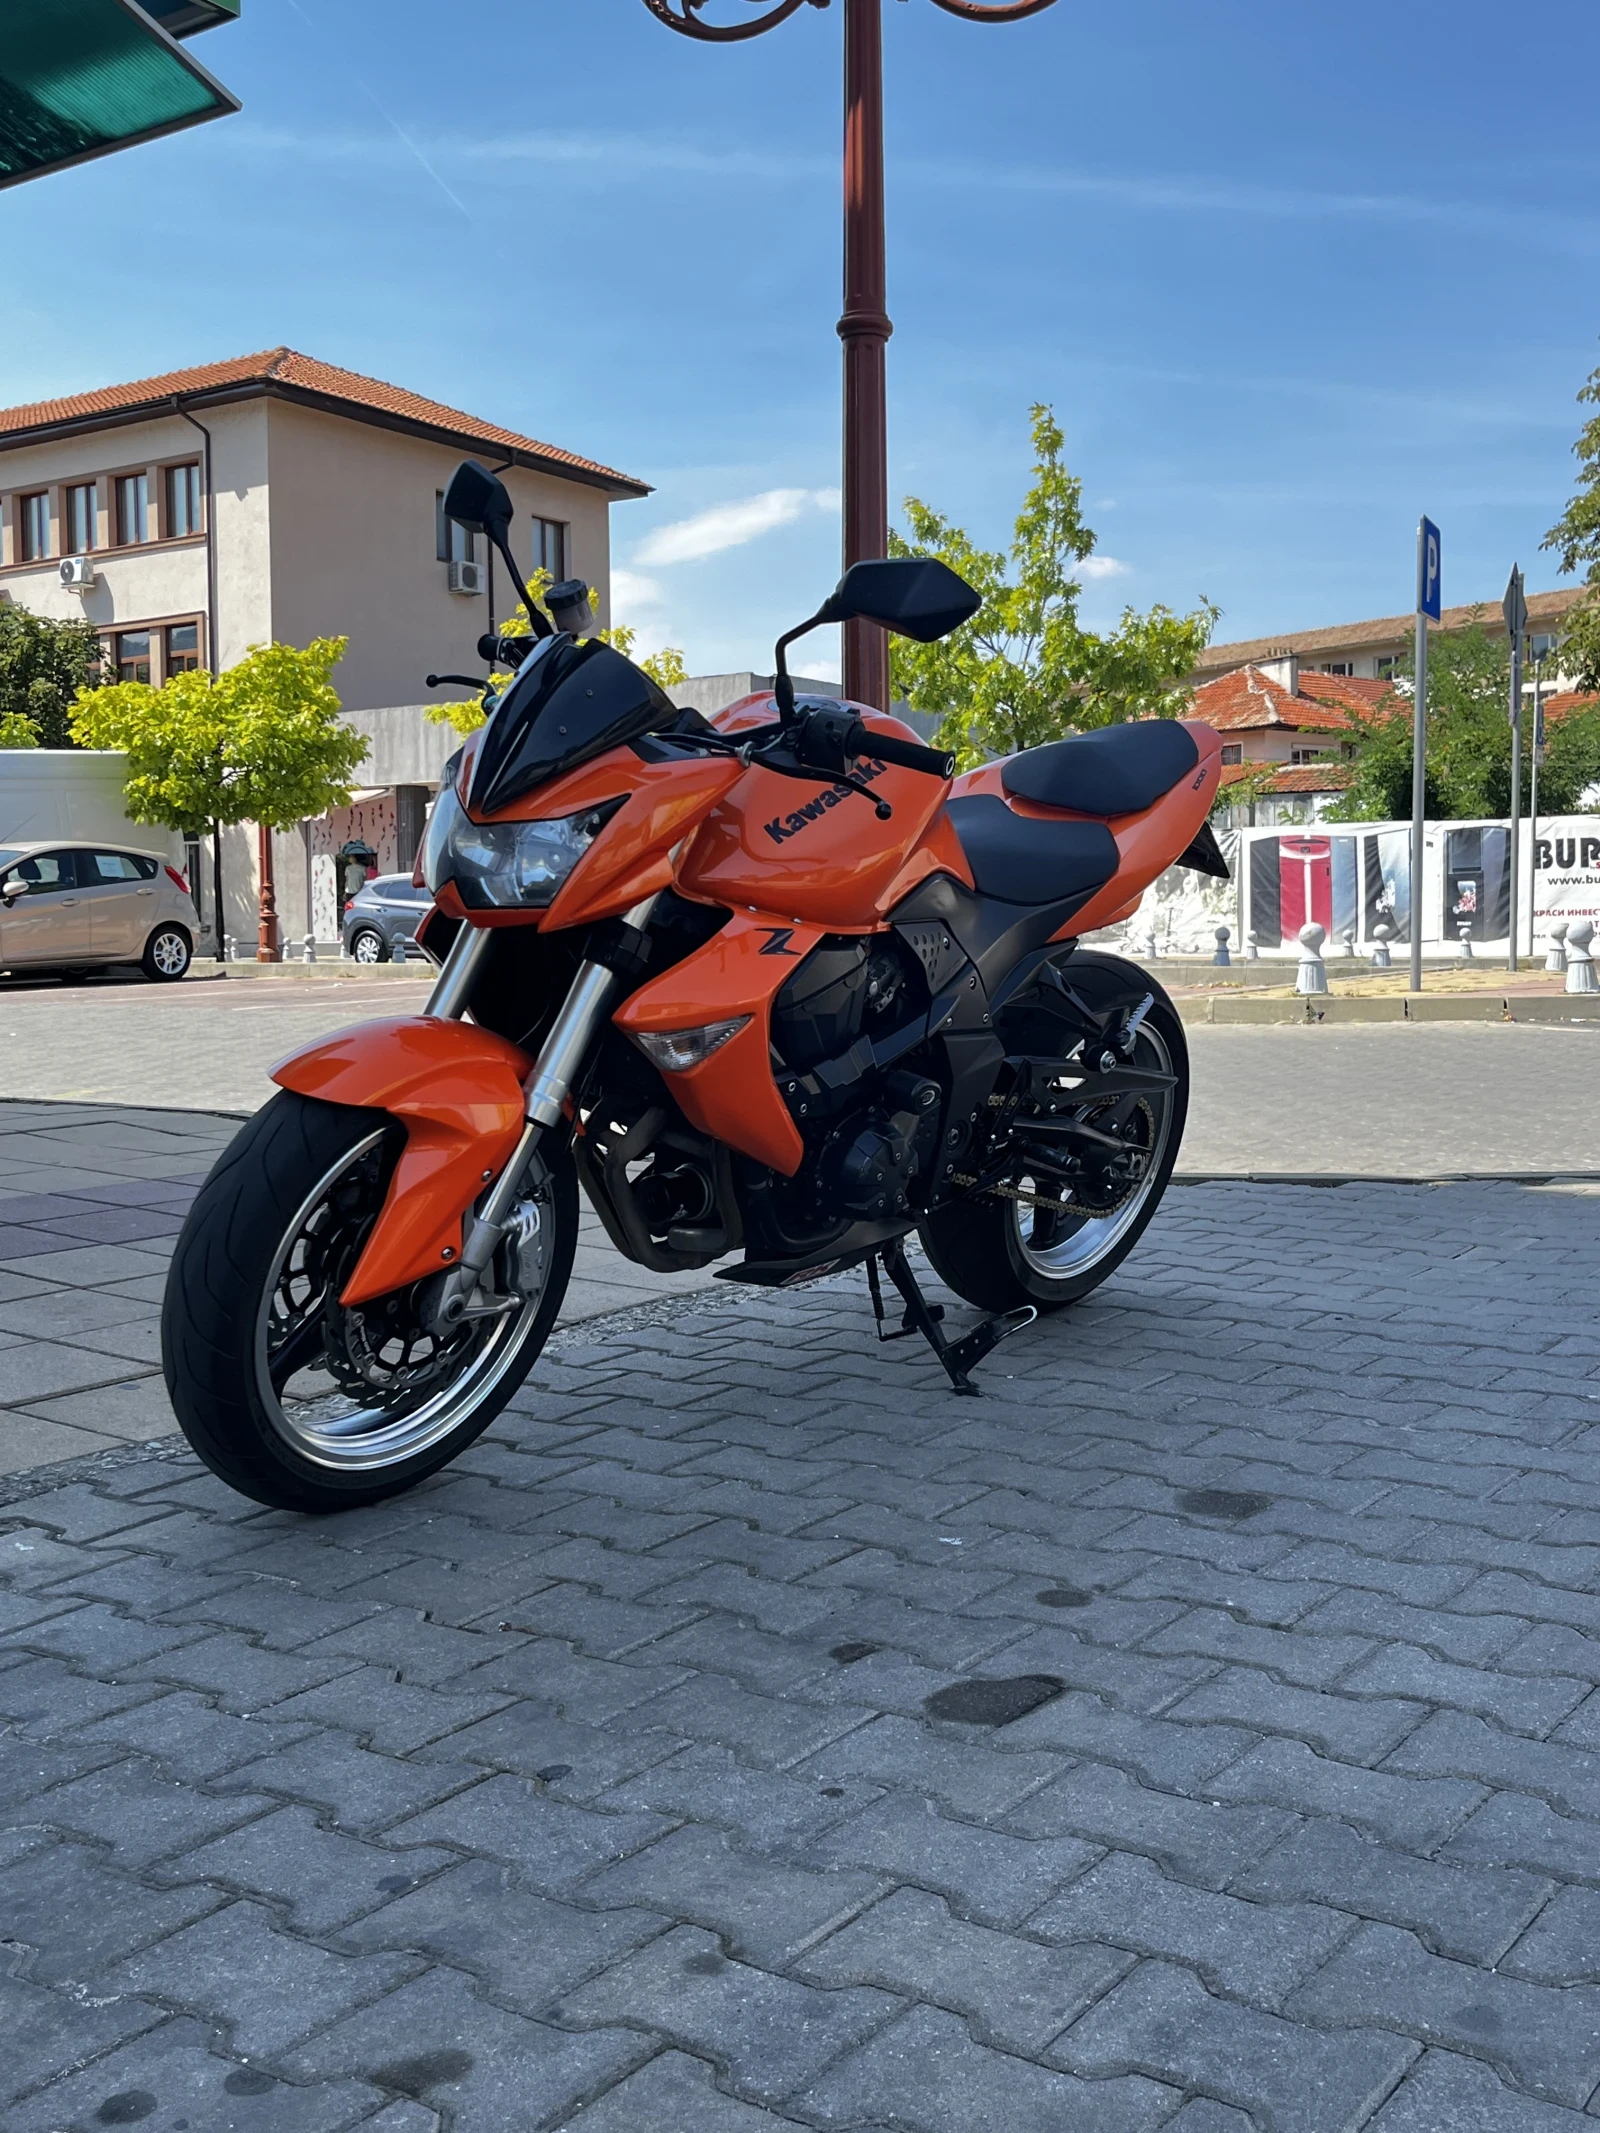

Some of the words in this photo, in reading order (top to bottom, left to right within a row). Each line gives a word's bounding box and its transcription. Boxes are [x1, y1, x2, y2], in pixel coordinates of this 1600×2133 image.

[1427, 534, 1437, 602] P
[763, 758, 887, 844] Kawasaki
[1567, 909, 1600, 917] ИНВЕС
